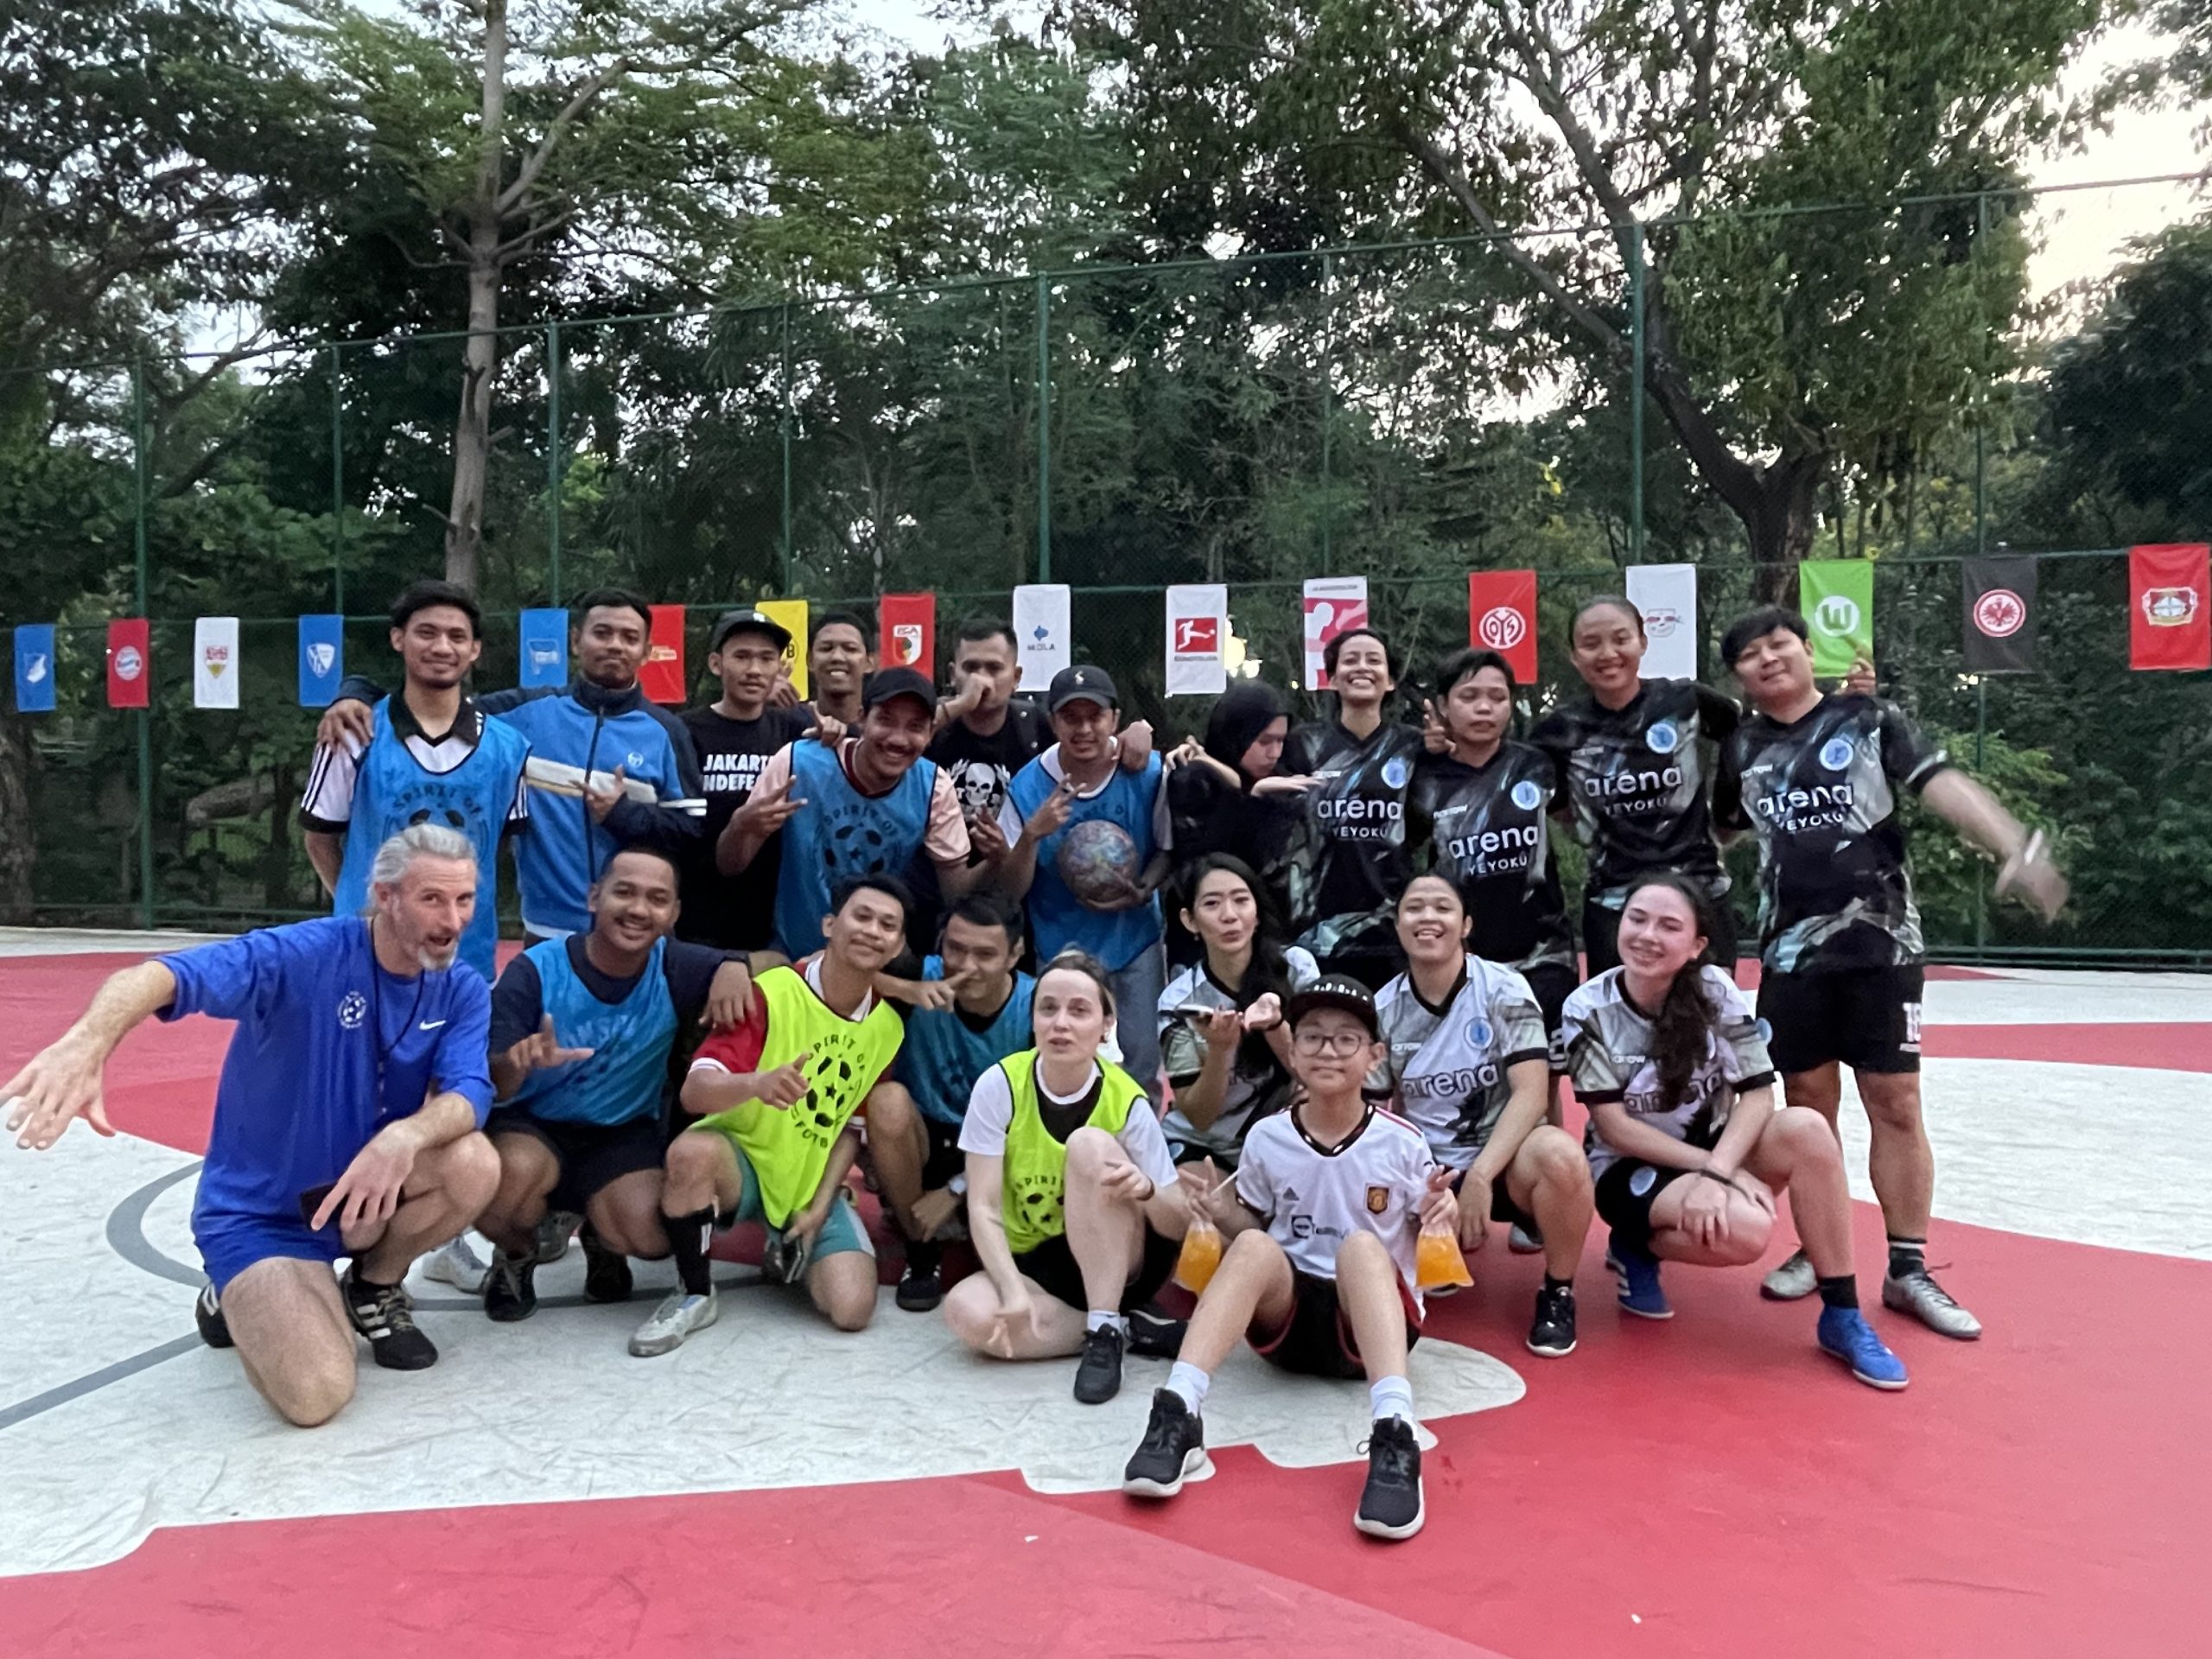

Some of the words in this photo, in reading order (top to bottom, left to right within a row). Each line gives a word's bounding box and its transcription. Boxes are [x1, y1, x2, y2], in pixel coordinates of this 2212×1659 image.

[703, 754, 770, 772] JAKART
[702, 773, 756, 791] NDEFE
[1585, 766, 1682, 797] arena
[1317, 798, 1402, 820] arena
[1757, 785, 1853, 817] arena
[1448, 825, 1538, 860] arena
[1402, 1062, 1500, 1099] arena
[1624, 1069, 1722, 1113] arna
